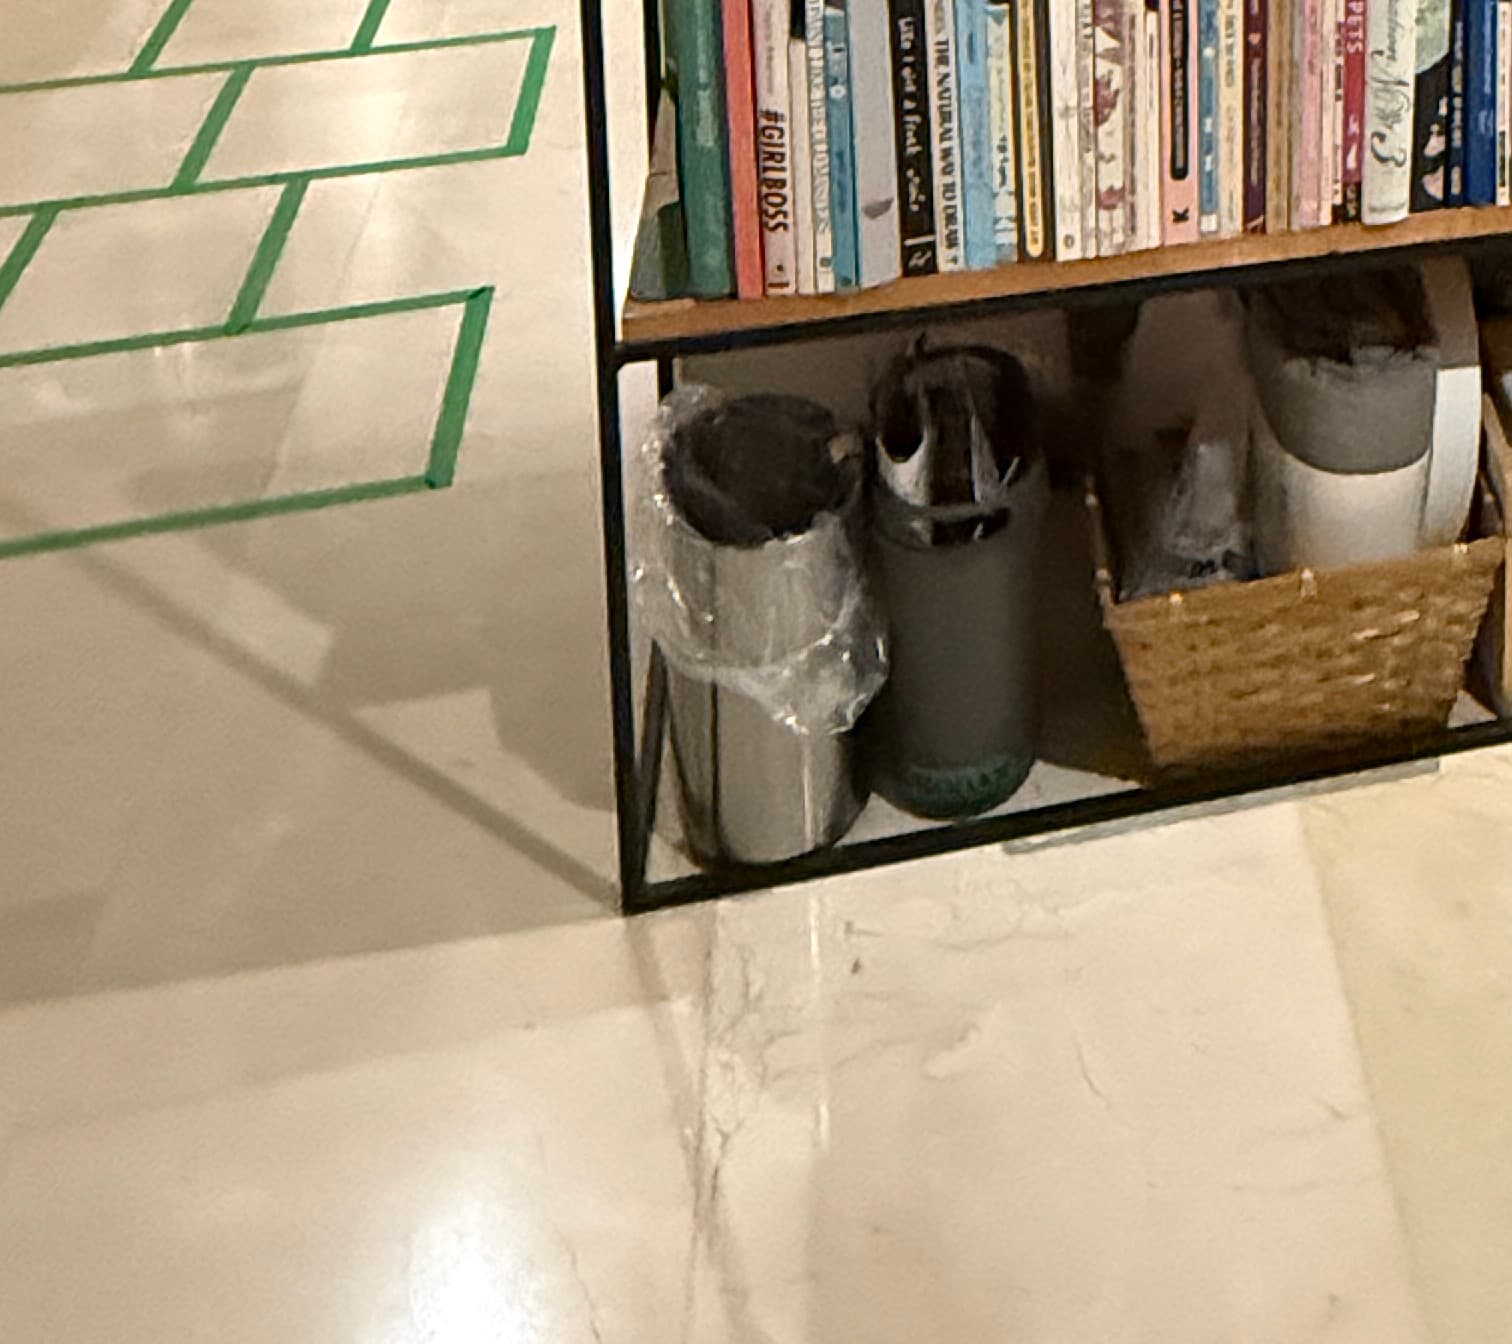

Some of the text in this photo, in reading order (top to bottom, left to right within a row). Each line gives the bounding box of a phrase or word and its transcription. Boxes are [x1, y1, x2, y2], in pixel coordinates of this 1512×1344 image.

[1346, 0, 1362, 53] PETS
[934, 39, 949, 70] THE
[936, 72, 953, 145] NATURAL
[760, 110, 789, 235] #GIRLBOSS
[939, 146, 954, 179] WAY
[942, 181, 957, 202] TO
[943, 204, 959, 250] DRAW
